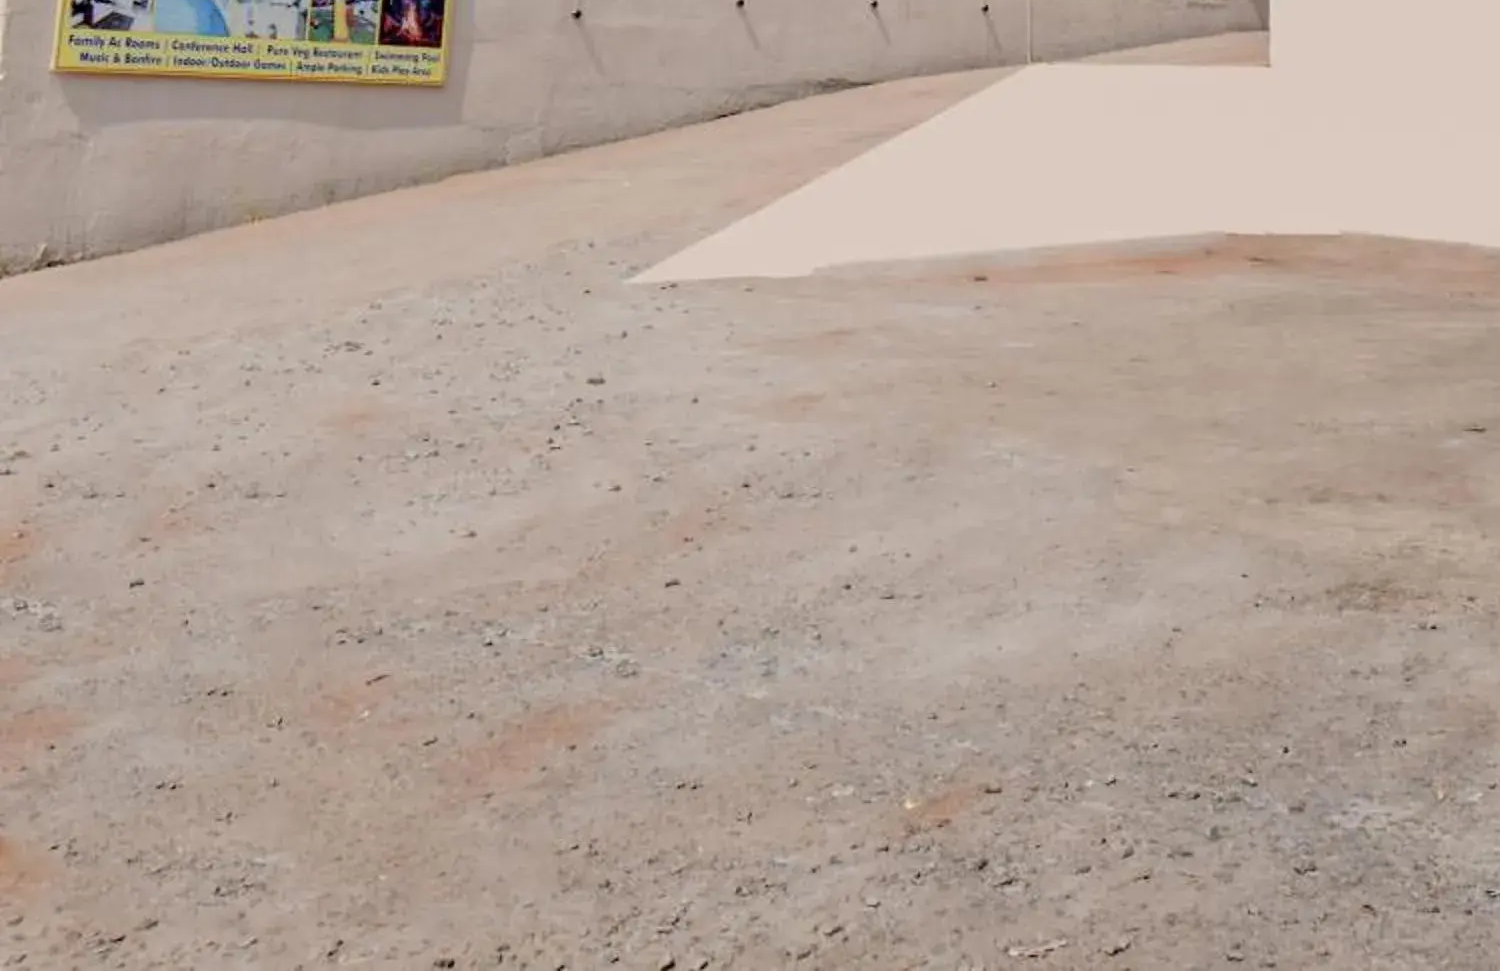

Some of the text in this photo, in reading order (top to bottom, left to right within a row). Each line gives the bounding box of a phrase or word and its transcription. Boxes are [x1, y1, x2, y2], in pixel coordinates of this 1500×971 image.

[68, 33, 105, 49] Family
[125, 36, 161, 50] Rooms
[171, 39, 229, 54] Conference
[233, 43, 254, 54] Hall
[80, 52, 109, 64] Music
[124, 53, 163, 66] Bonfire
